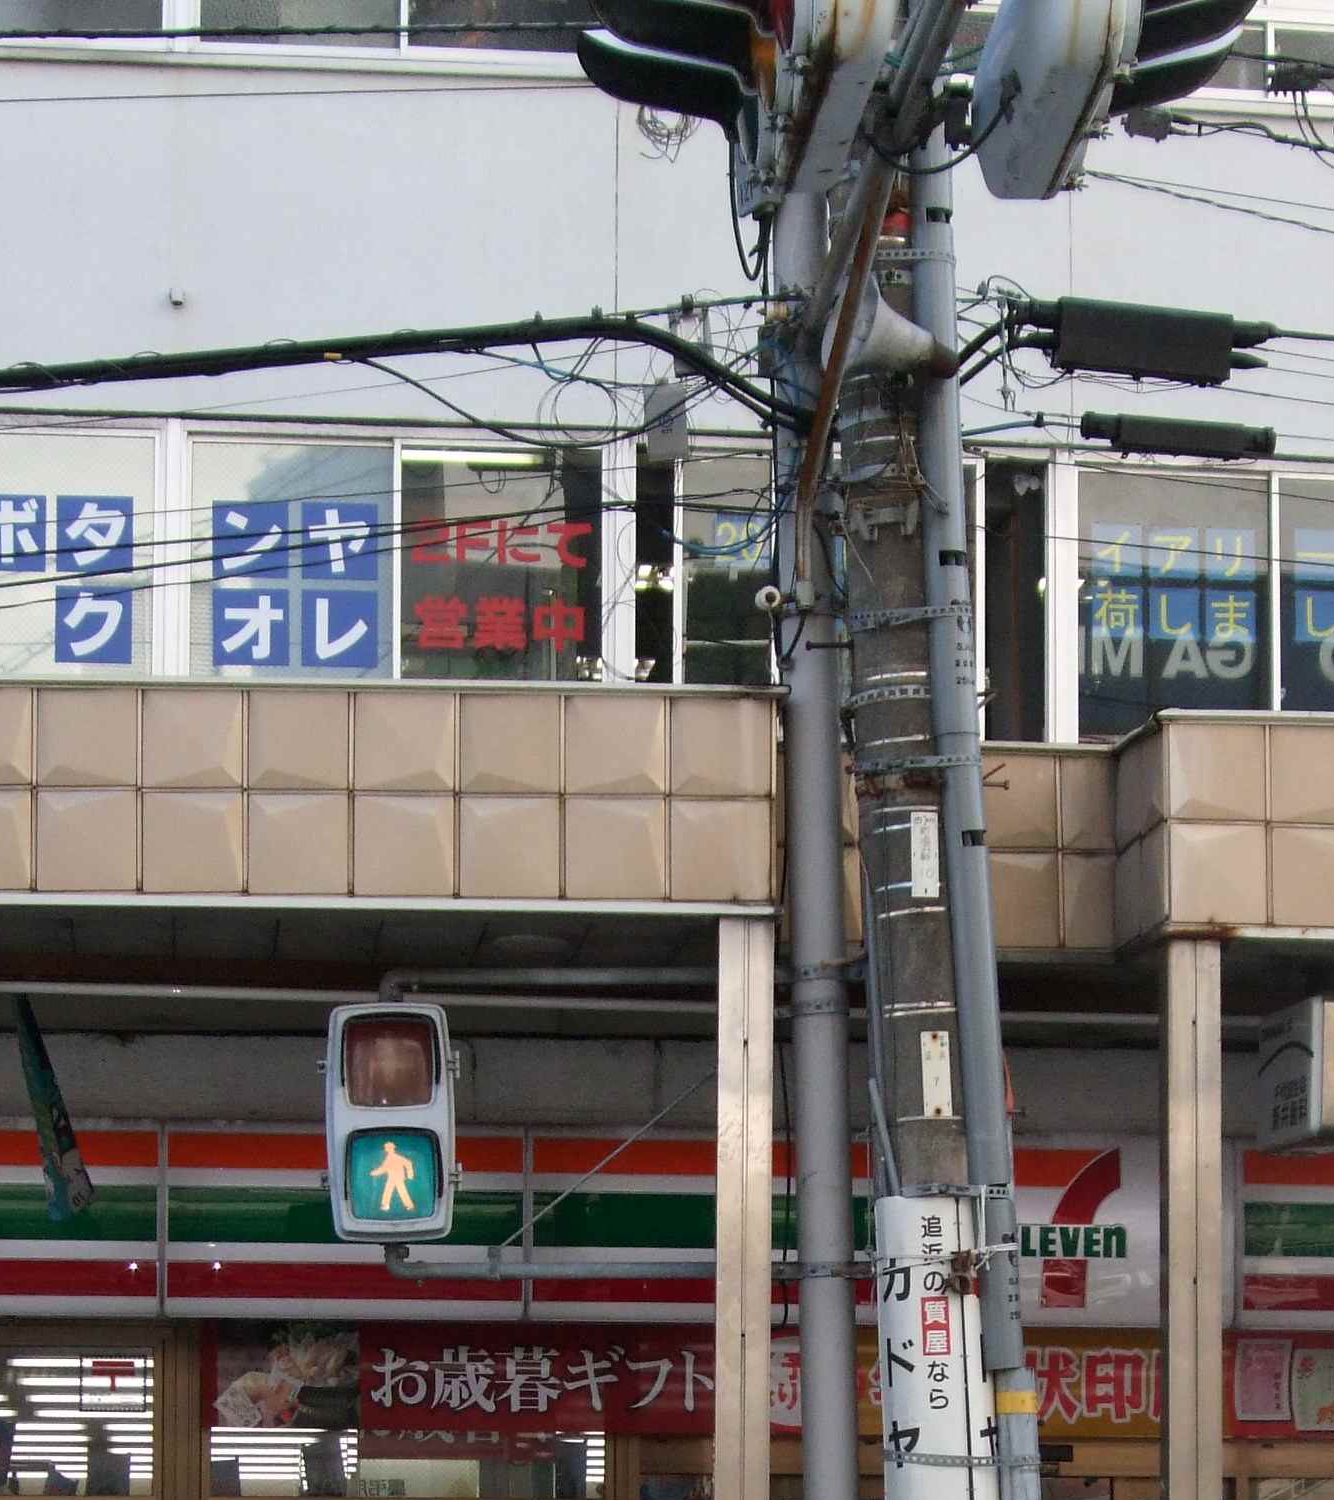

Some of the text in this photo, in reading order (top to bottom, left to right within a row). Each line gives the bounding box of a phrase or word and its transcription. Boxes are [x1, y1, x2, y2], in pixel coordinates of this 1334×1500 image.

[411, 598, 588, 654] 営業中
[1020, 1223, 1127, 1259] LEVEn
[920, 1215, 951, 1410] 追浜の質屋なら
[371, 1344, 715, 1414] お歳暮ギフト
